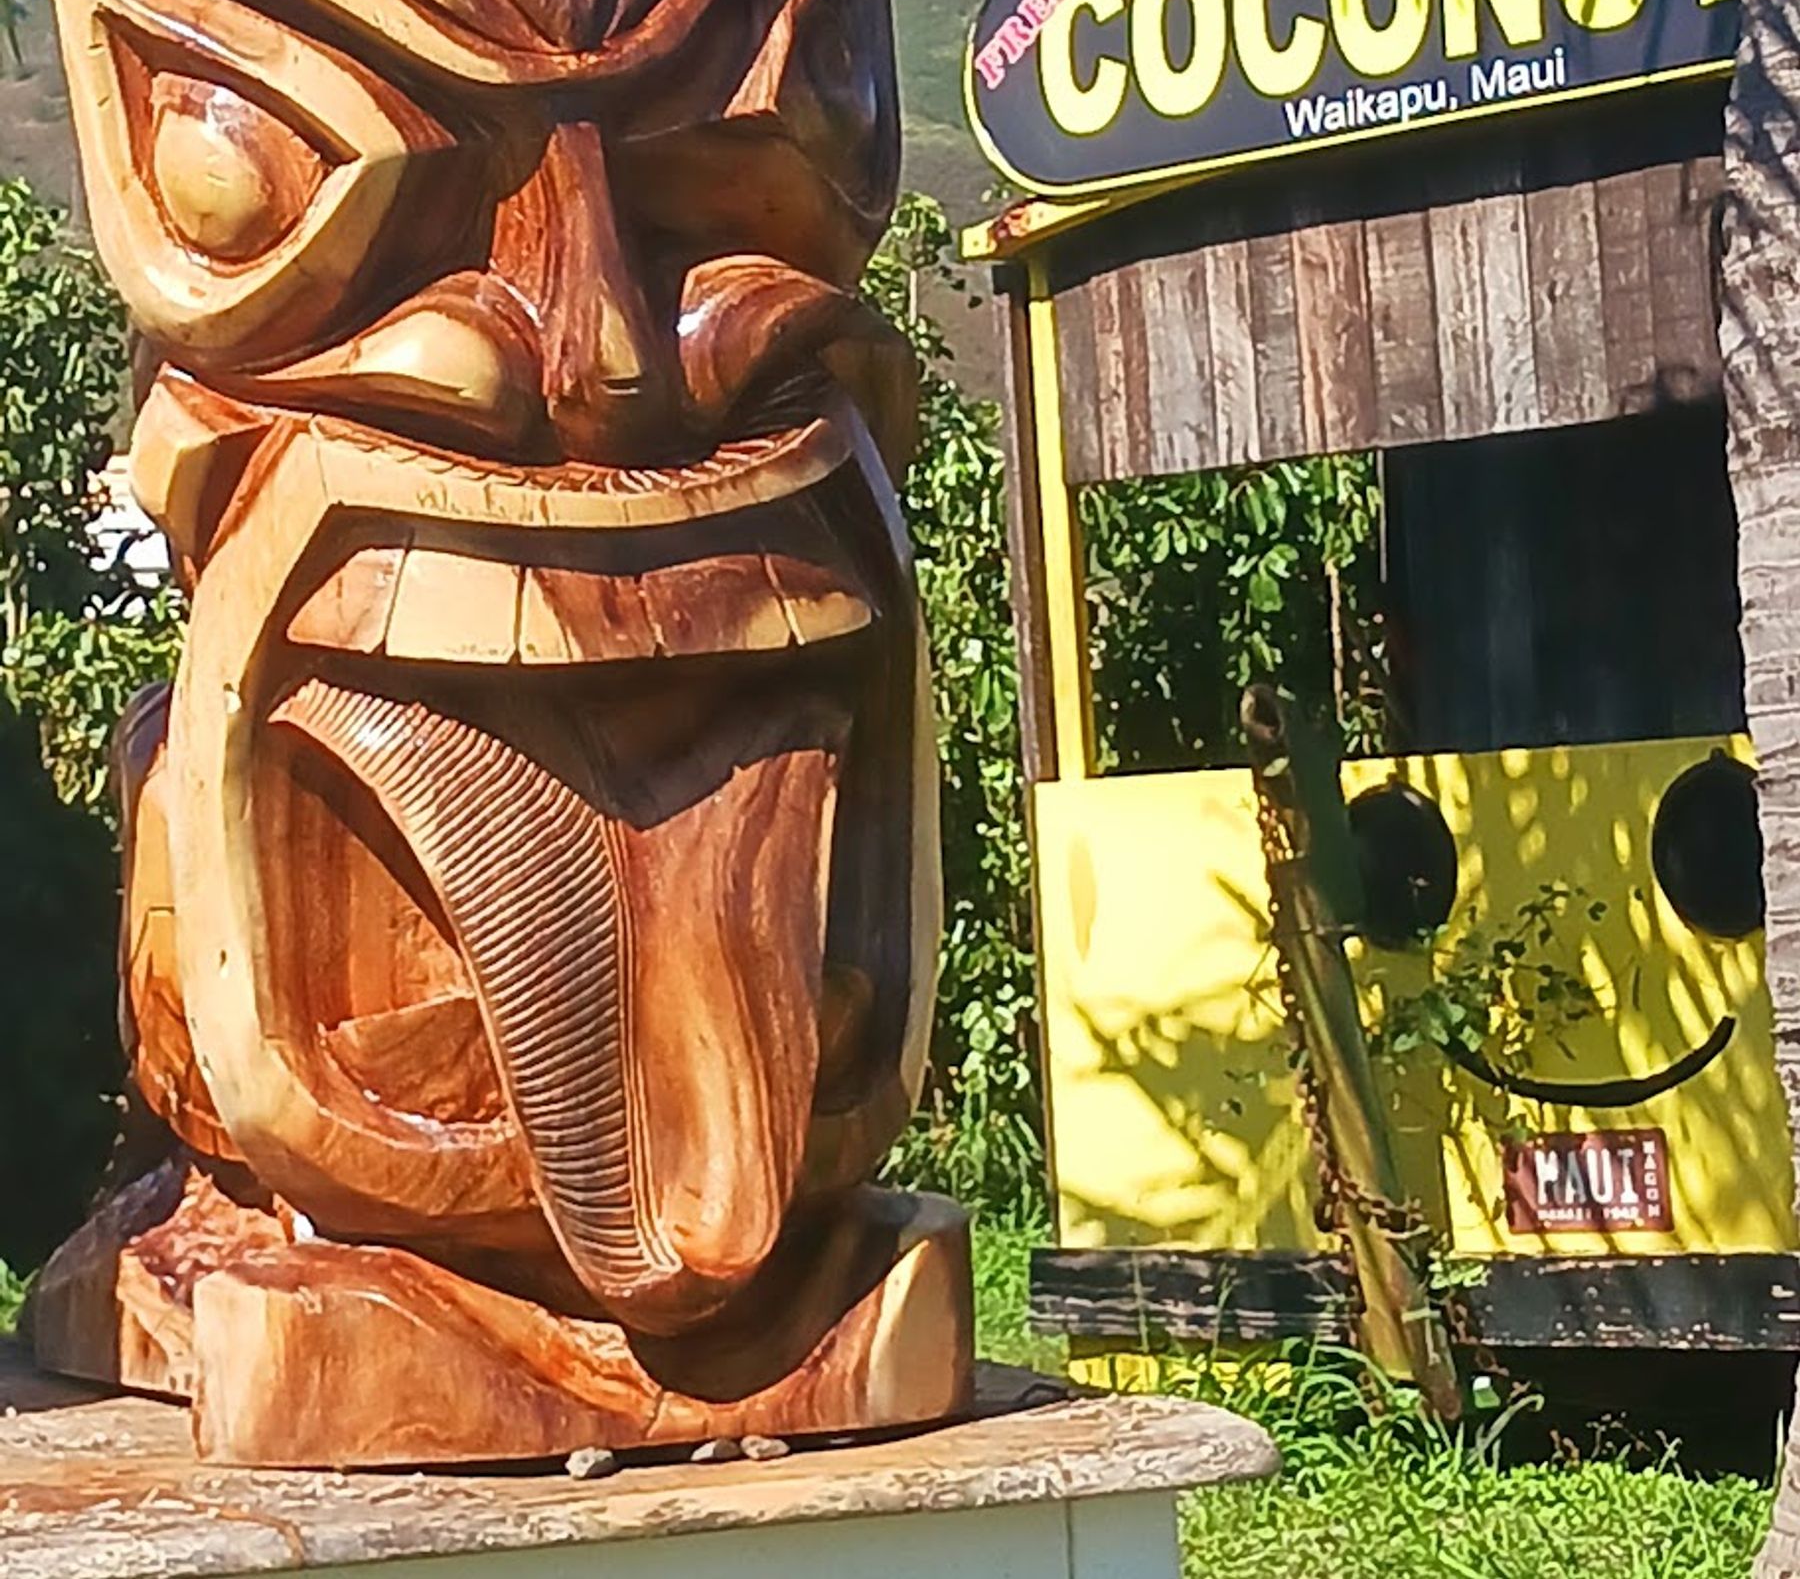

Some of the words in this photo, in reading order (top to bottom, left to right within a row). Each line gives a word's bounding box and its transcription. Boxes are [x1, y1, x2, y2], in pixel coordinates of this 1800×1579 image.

[1284, 79, 1459, 138] Waikapu,
[1470, 47, 1566, 102] Maui
[1534, 1148, 1639, 1206] MAUI
